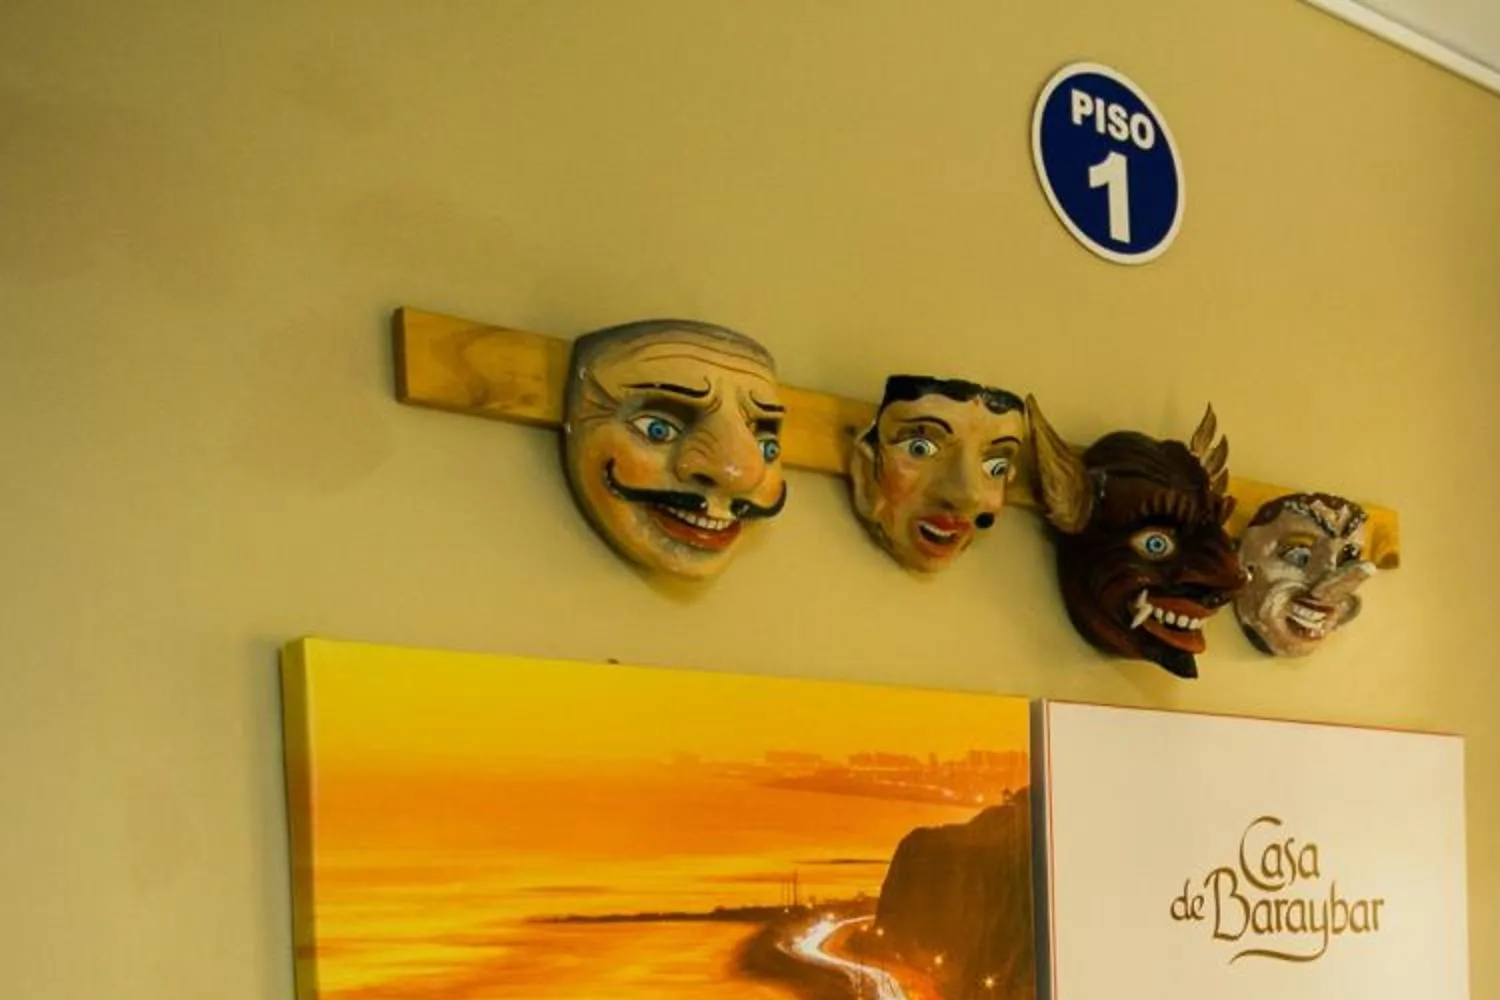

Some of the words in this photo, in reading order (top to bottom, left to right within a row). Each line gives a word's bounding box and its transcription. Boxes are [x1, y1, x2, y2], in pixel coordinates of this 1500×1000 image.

[1071, 87, 1156, 150] PISO
[1088, 151, 1131, 244] 1
[1239, 815, 1321, 893] Casa
[1170, 878, 1206, 922] de
[1203, 866, 1385, 965] Baraybar
